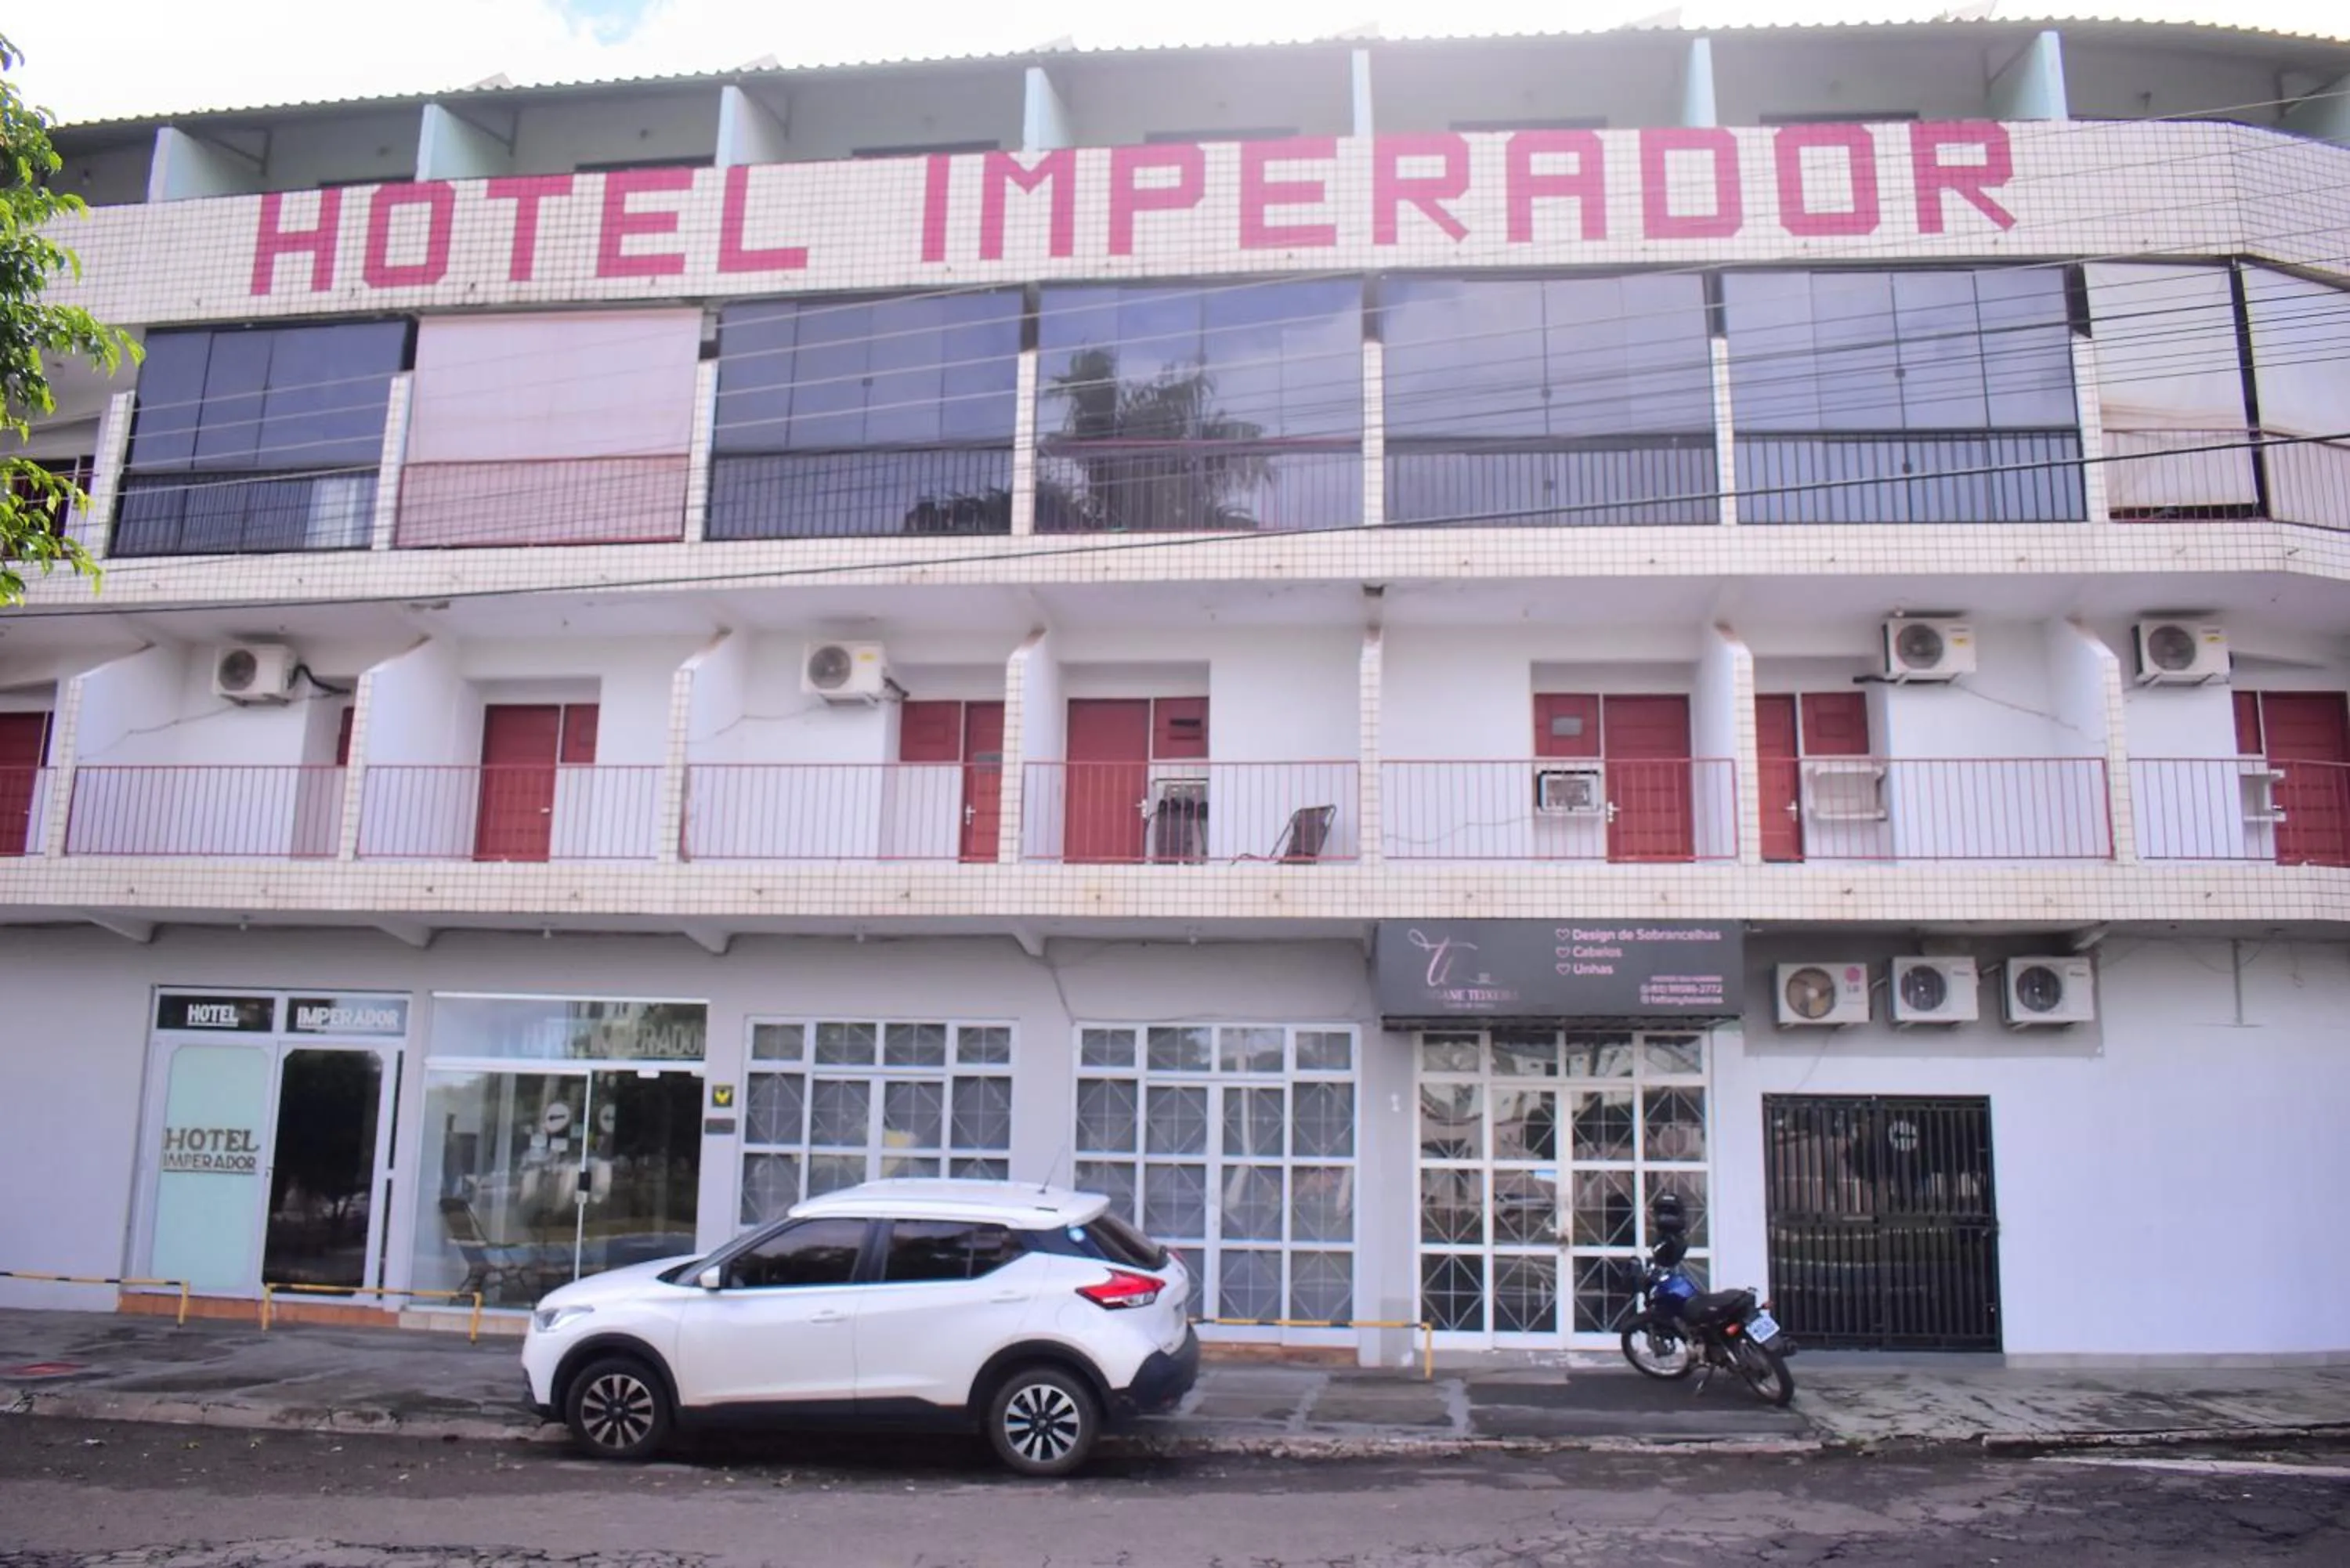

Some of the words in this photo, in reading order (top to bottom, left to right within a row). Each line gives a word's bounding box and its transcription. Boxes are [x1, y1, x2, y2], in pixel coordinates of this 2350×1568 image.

[250, 165, 808, 296] HOTEL
[921, 121, 2019, 262] IMPERADOR
[1572, 929, 1615, 942] Design
[1618, 930, 1634, 940] de
[1636, 929, 1721, 941] Sobrancelhas
[1572, 946, 1622, 957] Cabelos
[1573, 964, 1614, 974] Unhas
[188, 1004, 238, 1022] HOTEL
[298, 1006, 399, 1027] IMPERADOR
[163, 1128, 261, 1152] HOTEL
[163, 1153, 257, 1169] IMPERADOR
